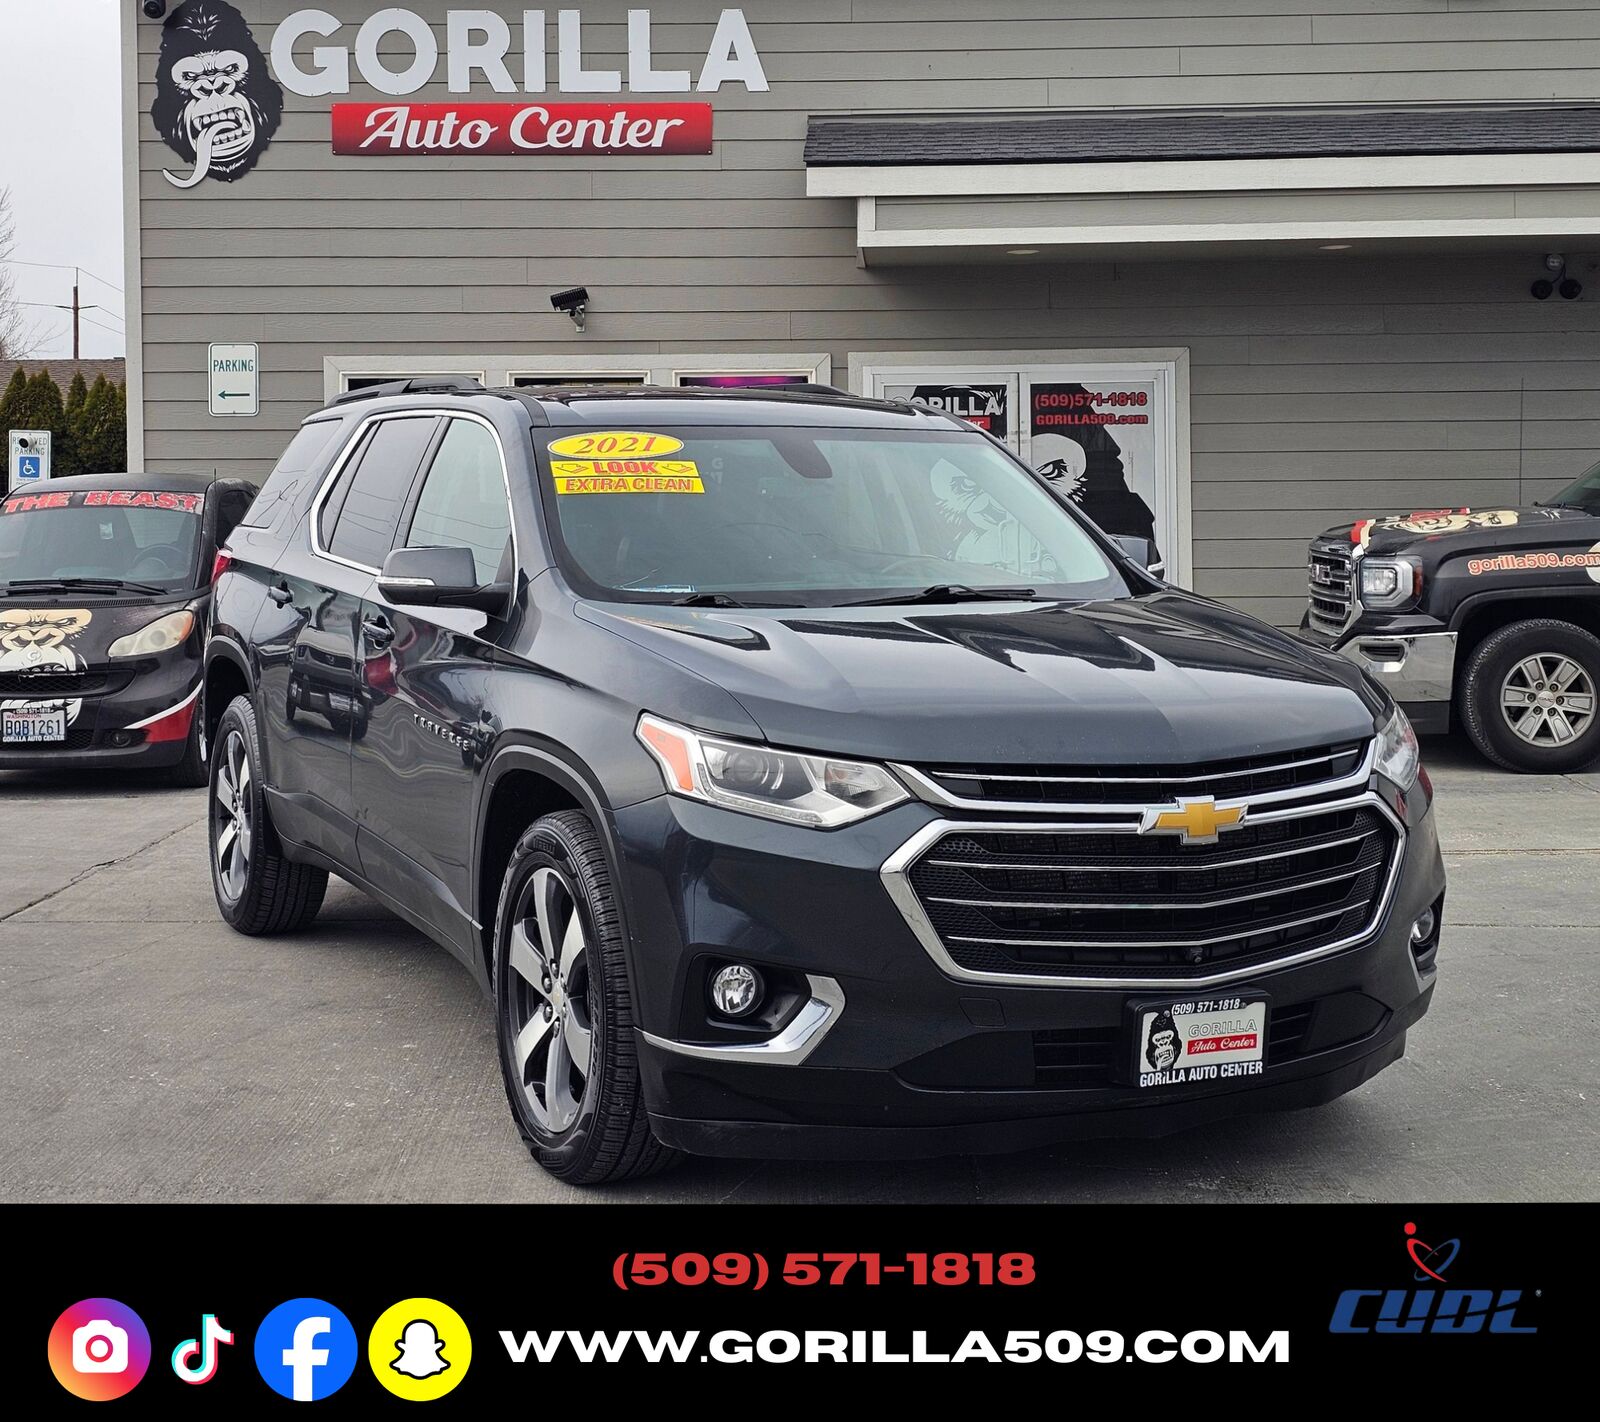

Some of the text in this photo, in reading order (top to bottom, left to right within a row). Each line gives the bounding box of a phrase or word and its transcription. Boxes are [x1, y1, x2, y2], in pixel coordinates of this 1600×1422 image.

[270, 8, 770, 96] GORILLA
[358, 105, 686, 150] Auto Center
[213, 359, 254, 372] PARKING
[1034, 392, 1148, 410] (509)571-1818
[1035, 412, 1149, 426] GORILLA509.com
[574, 436, 657, 454] 2021
[592, 461, 661, 475] LOOK
[565, 477, 694, 492] EXTRA CLEAN
[4, 490, 203, 514] THE BEAST
[1467, 552, 1600, 576] gorilla509.com
[5, 719, 61, 736] BQB1261
[1171, 998, 1240, 1016] (509) 571-1818
[1188, 1019, 1257, 1037] GORILLA
[1191, 1038, 1256, 1054] Auto Center
[1139, 1060, 1264, 1088] GORILLA AUTO CENTER
